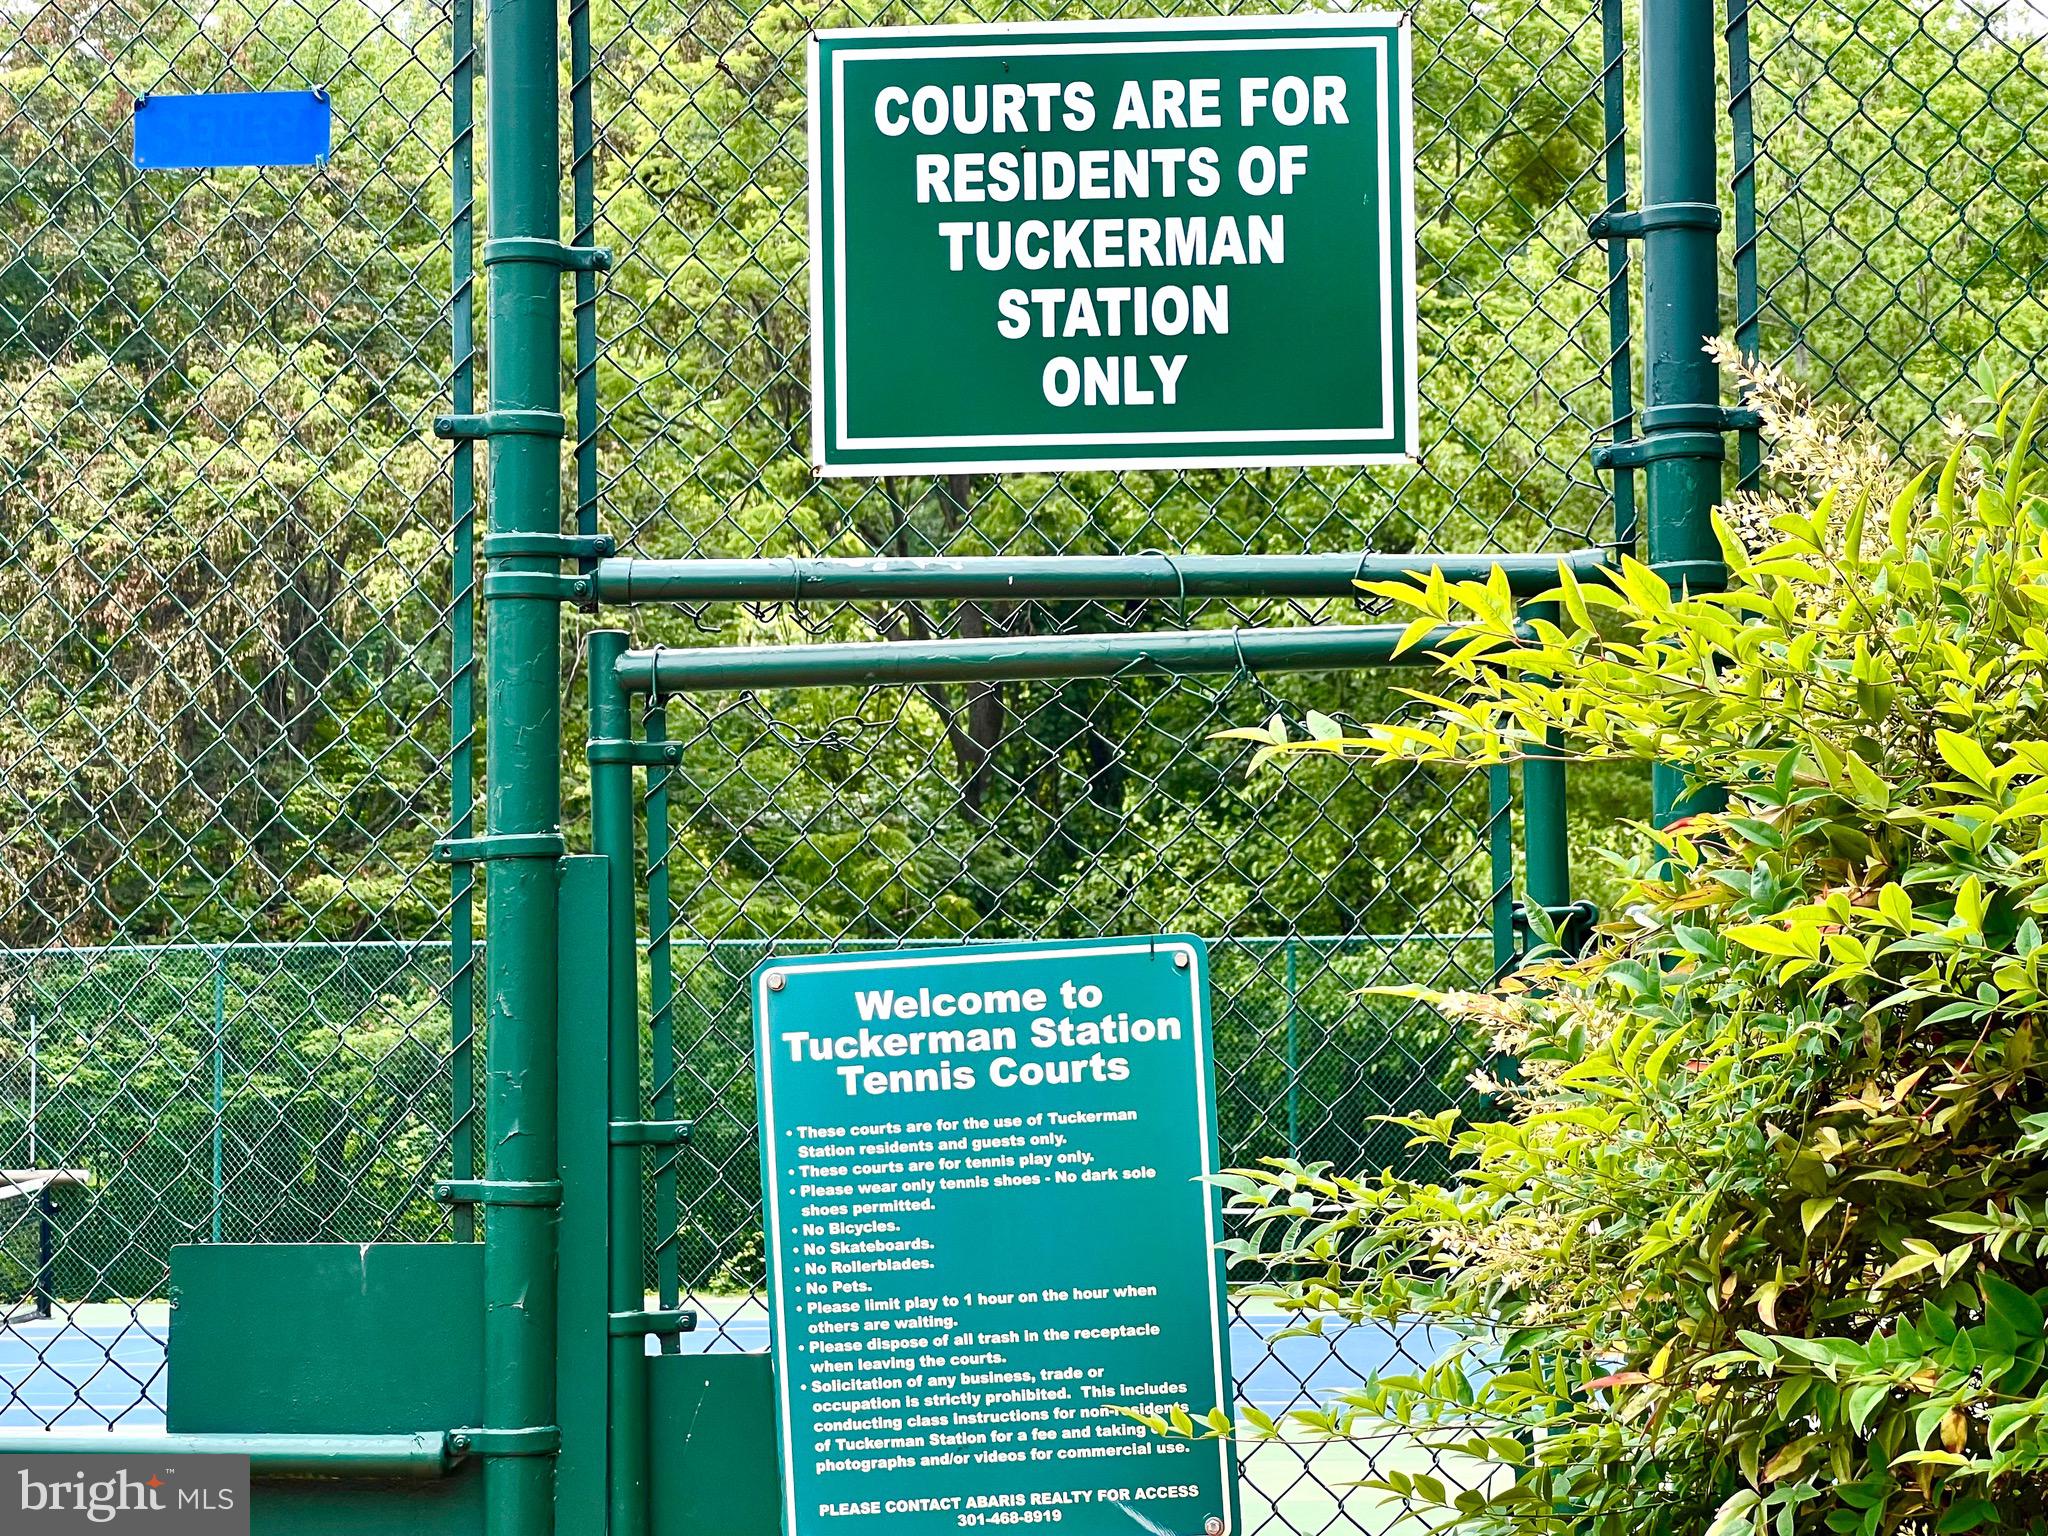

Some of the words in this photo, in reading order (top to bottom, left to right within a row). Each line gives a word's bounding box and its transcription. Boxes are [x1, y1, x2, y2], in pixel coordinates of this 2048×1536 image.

[874, 81, 1095, 136] COURTS
[1112, 78, 1221, 129] ARE
[1240, 75, 1349, 126] FOR
[916, 147, 1220, 203] RESIDENTS
[1238, 144, 1308, 196] OF
[938, 214, 1284, 271] TUCKERMAN
[997, 284, 1228, 339] STATION
[1042, 354, 1187, 407] ONLY
[854, 987, 1047, 1020] Welcome
[1059, 979, 1102, 1009] to
[781, 1027, 1016, 1061] Tuckerman
[1030, 1012, 1181, 1048] Station
[836, 1060, 975, 1095] Tennis
[989, 1052, 1130, 1087] Courts
[796, 1126, 846, 1139] These
[850, 1122, 902, 1136] courts
[906, 1122, 932, 1133] are
[936, 1118, 959, 1131] for
[962, 1117, 989, 1129] the
[993, 1116, 1022, 1128] use
[1026, 1112, 1043, 1126] of
[1047, 1110, 1137, 1125] Tuckerman
[798, 1144, 855, 1158] Station
[859, 1140, 934, 1155] residents
[938, 1137, 967, 1151] and
[971, 1134, 1025, 1152] guests
[1029, 1132, 1067, 1147] only.
[798, 1164, 848, 1177] These
[852, 1161, 904, 1175] courts
[908, 1161, 935, 1172] are
[938, 1157, 961, 1170] for
[965, 1154, 1015, 1168] tennis
[1019, 1152, 1053, 1168] play
[1057, 1150, 1094, 1165] only.
[800, 1184, 853, 1197] Please
[857, 1182, 897, 1194] wear
[901, 1178, 935, 1193] only
[939, 1175, 989, 1189] tennis
[993, 1174, 1040, 1187] shoes
[1054, 1170, 1077, 1183] No
[1081, 1167, 1118, 1182] dark
[1122, 1165, 1156, 1179] sole
[801, 1203, 848, 1217] shoes
[852, 1197, 935, 1217] permitted.
[802, 1223, 824, 1236] No
[828, 1220, 900, 1236] Bicycles.
[803, 1243, 826, 1255] No
[829, 1237, 934, 1254] Skateboards.
[805, 1262, 827, 1275] No
[831, 1257, 934, 1273] Rollerblades.
[806, 1281, 827, 1294] No
[832, 1280, 872, 1293] Pets.
[807, 1301, 860, 1314] Please
[864, 1297, 900, 1311] limit
[904, 1296, 938, 1312] play
[941, 1295, 959, 1307] to
[963, 1293, 971, 1305] 1
[977, 1292, 1014, 1305] hour
[1017, 1292, 1037, 1303] on
[1041, 1289, 1068, 1301] the
[1072, 1287, 1109, 1300] hour
[1112, 1284, 1156, 1297] when
[808, 1320, 859, 1334] others
[863, 1320, 890, 1330] are
[894, 1315, 958, 1330] waiting.
[809, 1340, 862, 1353] Please
[866, 1337, 928, 1352] dispose
[932, 1333, 949, 1347] of
[953, 1332, 973, 1346] all
[977, 1330, 1019, 1344] trash
[1024, 1329, 1039, 1342] in
[1043, 1328, 1069, 1341] the
[1074, 1323, 1160, 1340] receptacle
[810, 1360, 853, 1373] when
[857, 1356, 915, 1371] leaving
[919, 1354, 945, 1367] the
[949, 1351, 1007, 1365] courts.
[811, 1376, 902, 1393] Solicitation
[906, 1374, 923, 1387] of
[927, 1375, 956, 1389] any
[960, 1371, 1036, 1385] business,
[1039, 1366, 1083, 1381] trade
[1087, 1368, 1104, 1378] or
[812, 1396, 901, 1413] occupation
[905, 1395, 919, 1407] is
[924, 1391, 981, 1407] strictly
[985, 1386, 1071, 1406] prohibited.
[1080, 1384, 1116, 1398] This
[1120, 1381, 1187, 1396] includes
[813, 1416, 902, 1432] conducting
[906, 1414, 948, 1427] class
[953, 1409, 1049, 1425] instructions
[1052, 1407, 1076, 1419] for
[814, 1438, 831, 1452] of
[834, 1436, 924, 1451] Tuckerman
[929, 1431, 986, 1446] Station
[990, 1429, 1013, 1443] for
[1017, 1431, 1027, 1441] a
[1031, 1427, 1057, 1440] fee
[1061, 1425, 1091, 1439] and
[1095, 1423, 1146, 1438] taking
[815, 1455, 916, 1474] photographs
[920, 1452, 970, 1466] and/or
[973, 1450, 1026, 1463] videos
[1030, 1447, 1053, 1460] for
[1056, 1441, 1151, 1459] commercial
[1156, 1443, 1190, 1454] use.
[819, 1501, 881, 1516] PLEASE
[885, 1496, 961, 1513] CONTACT
[965, 1493, 1026, 1509] ABARIS
[1030, 1489, 1093, 1505] REALTY
[1097, 1488, 1130, 1502] FOR
[1134, 1484, 1199, 1500] ACCESS
[957, 1509, 1062, 1527] 301-468-8919
